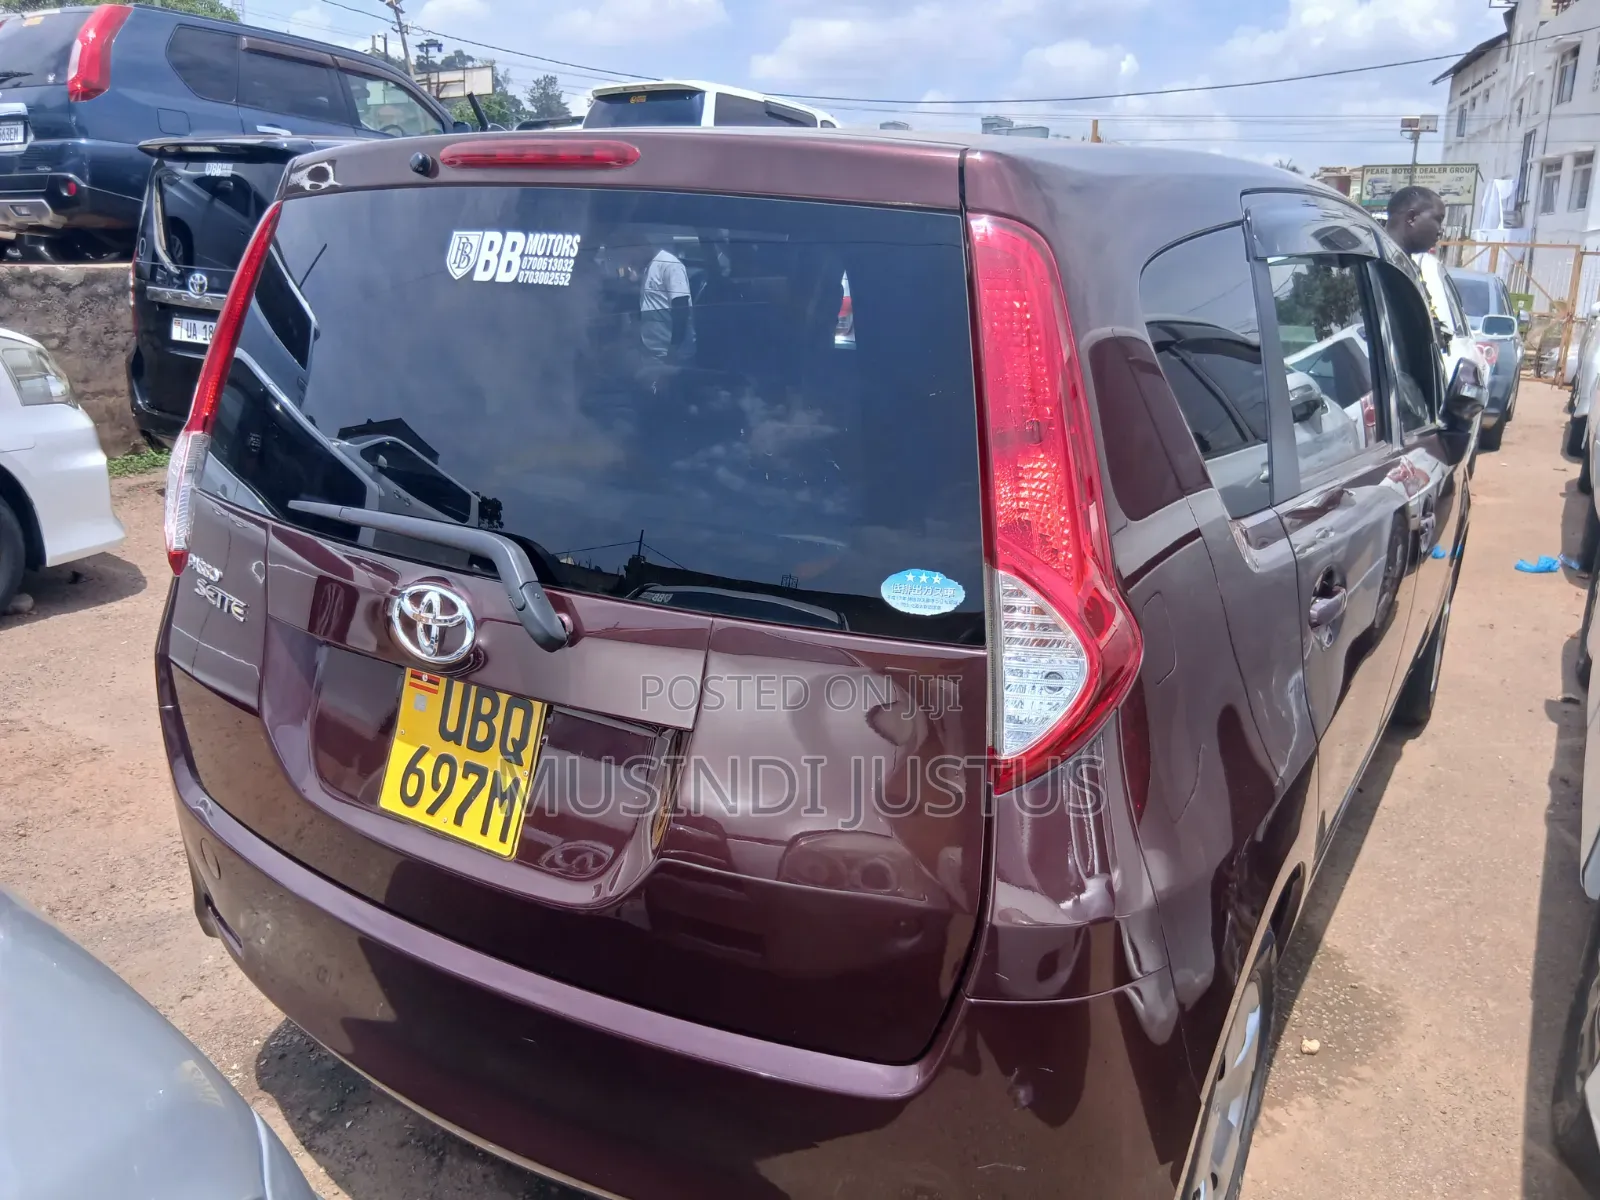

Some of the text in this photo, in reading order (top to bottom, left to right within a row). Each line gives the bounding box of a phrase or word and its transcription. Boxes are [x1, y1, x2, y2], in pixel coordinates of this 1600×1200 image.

[1391, 167, 1417, 175] MOTOR
[1449, 166, 1475, 174] GROUP
[473, 231, 581, 283] BB MOTORS
[521, 256, 575, 272] 0700613032
[517, 270, 571, 286] 0703002552
[186, 321, 217, 341] UA 18
[194, 578, 249, 623] SETTE
[438, 679, 534, 766] UBQ
[399, 744, 521, 844] 697M
